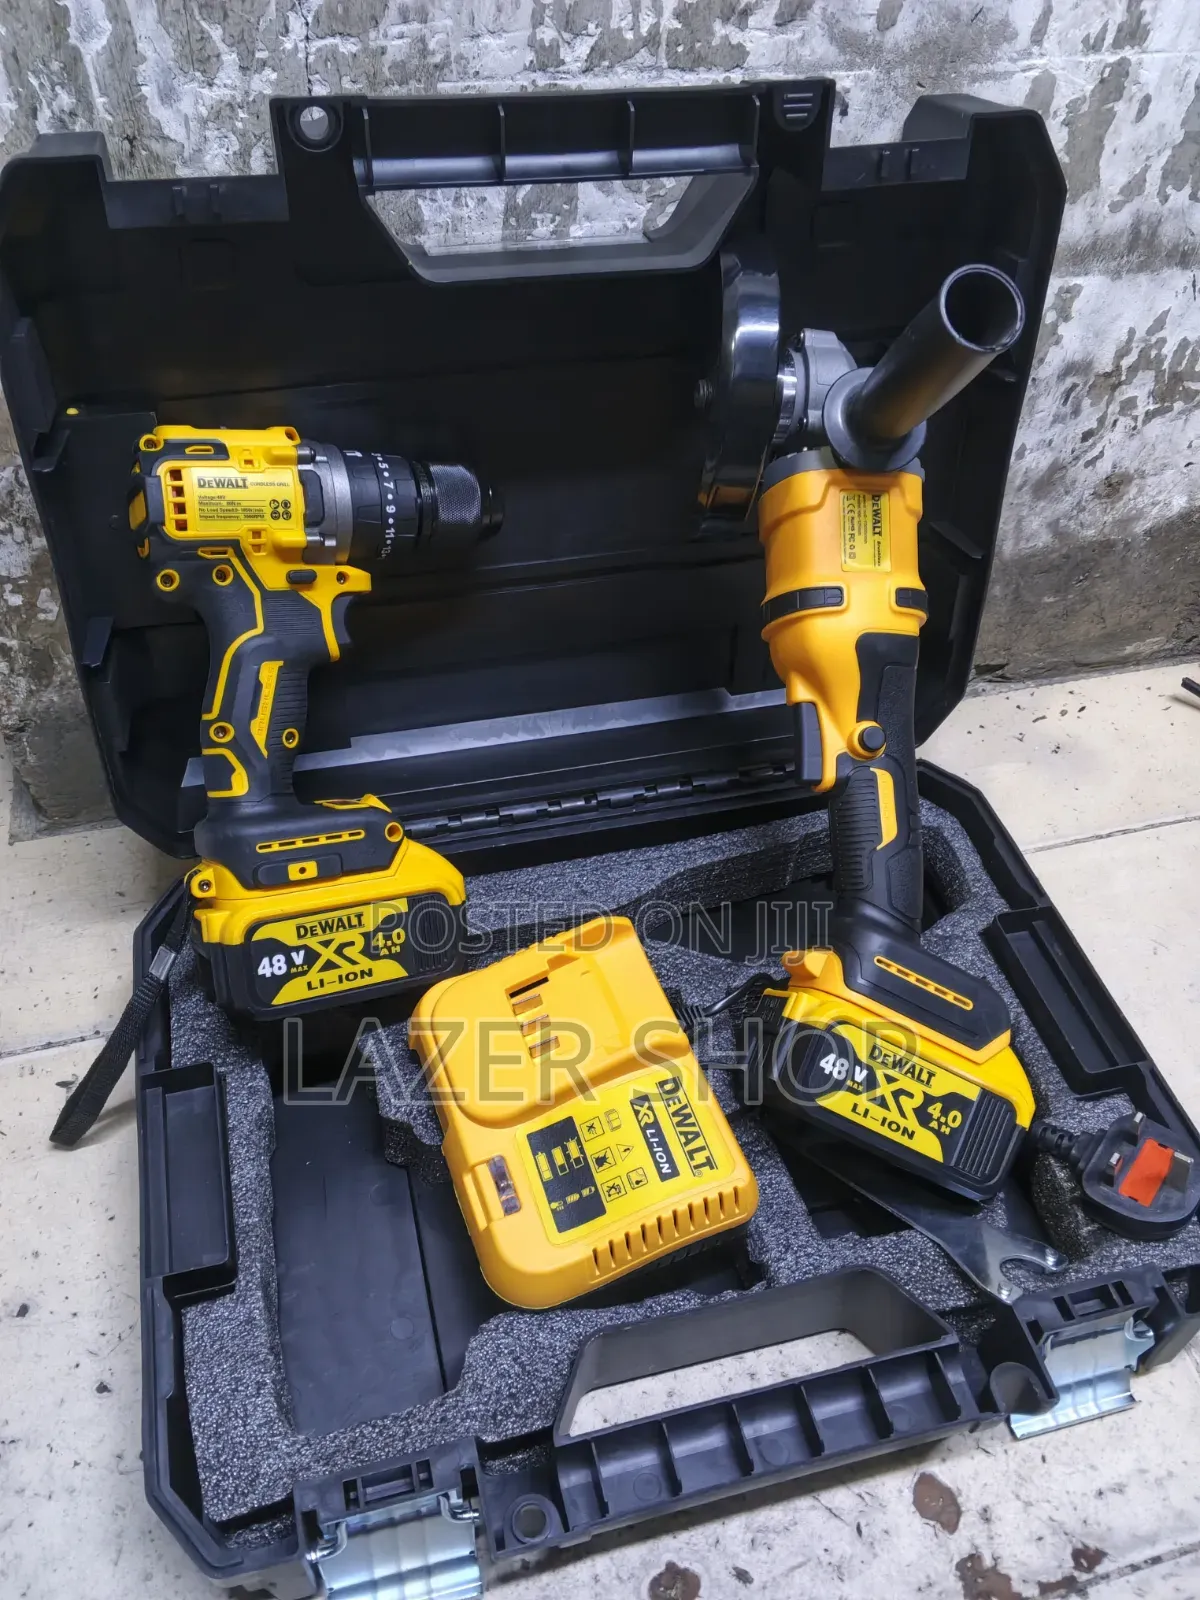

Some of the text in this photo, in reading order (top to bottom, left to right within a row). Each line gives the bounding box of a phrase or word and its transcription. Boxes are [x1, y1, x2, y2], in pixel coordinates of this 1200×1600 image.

[198, 476, 248, 488] DEWALT
[386, 506, 396, 514] 9
[872, 494, 882, 537] DEWALT
[385, 528, 396, 538] 11
[295, 912, 365, 940] DEWALT
[372, 928, 406, 948] 4.0
[379, 944, 401, 956] AH
[258, 950, 305, 978] 48 V
[290, 964, 308, 974] MAX
[307, 967, 374, 991] LI-ION
[820, 1053, 868, 1082] 48 V
[869, 1044, 936, 1088] DEWALT
[846, 1080, 863, 1092] MAX
[850, 1102, 916, 1140] LI-ION
[927, 1102, 962, 1129] 4.0
[632, 1101, 672, 1174] XR LI-ION
[928, 1121, 952, 1136] AH
